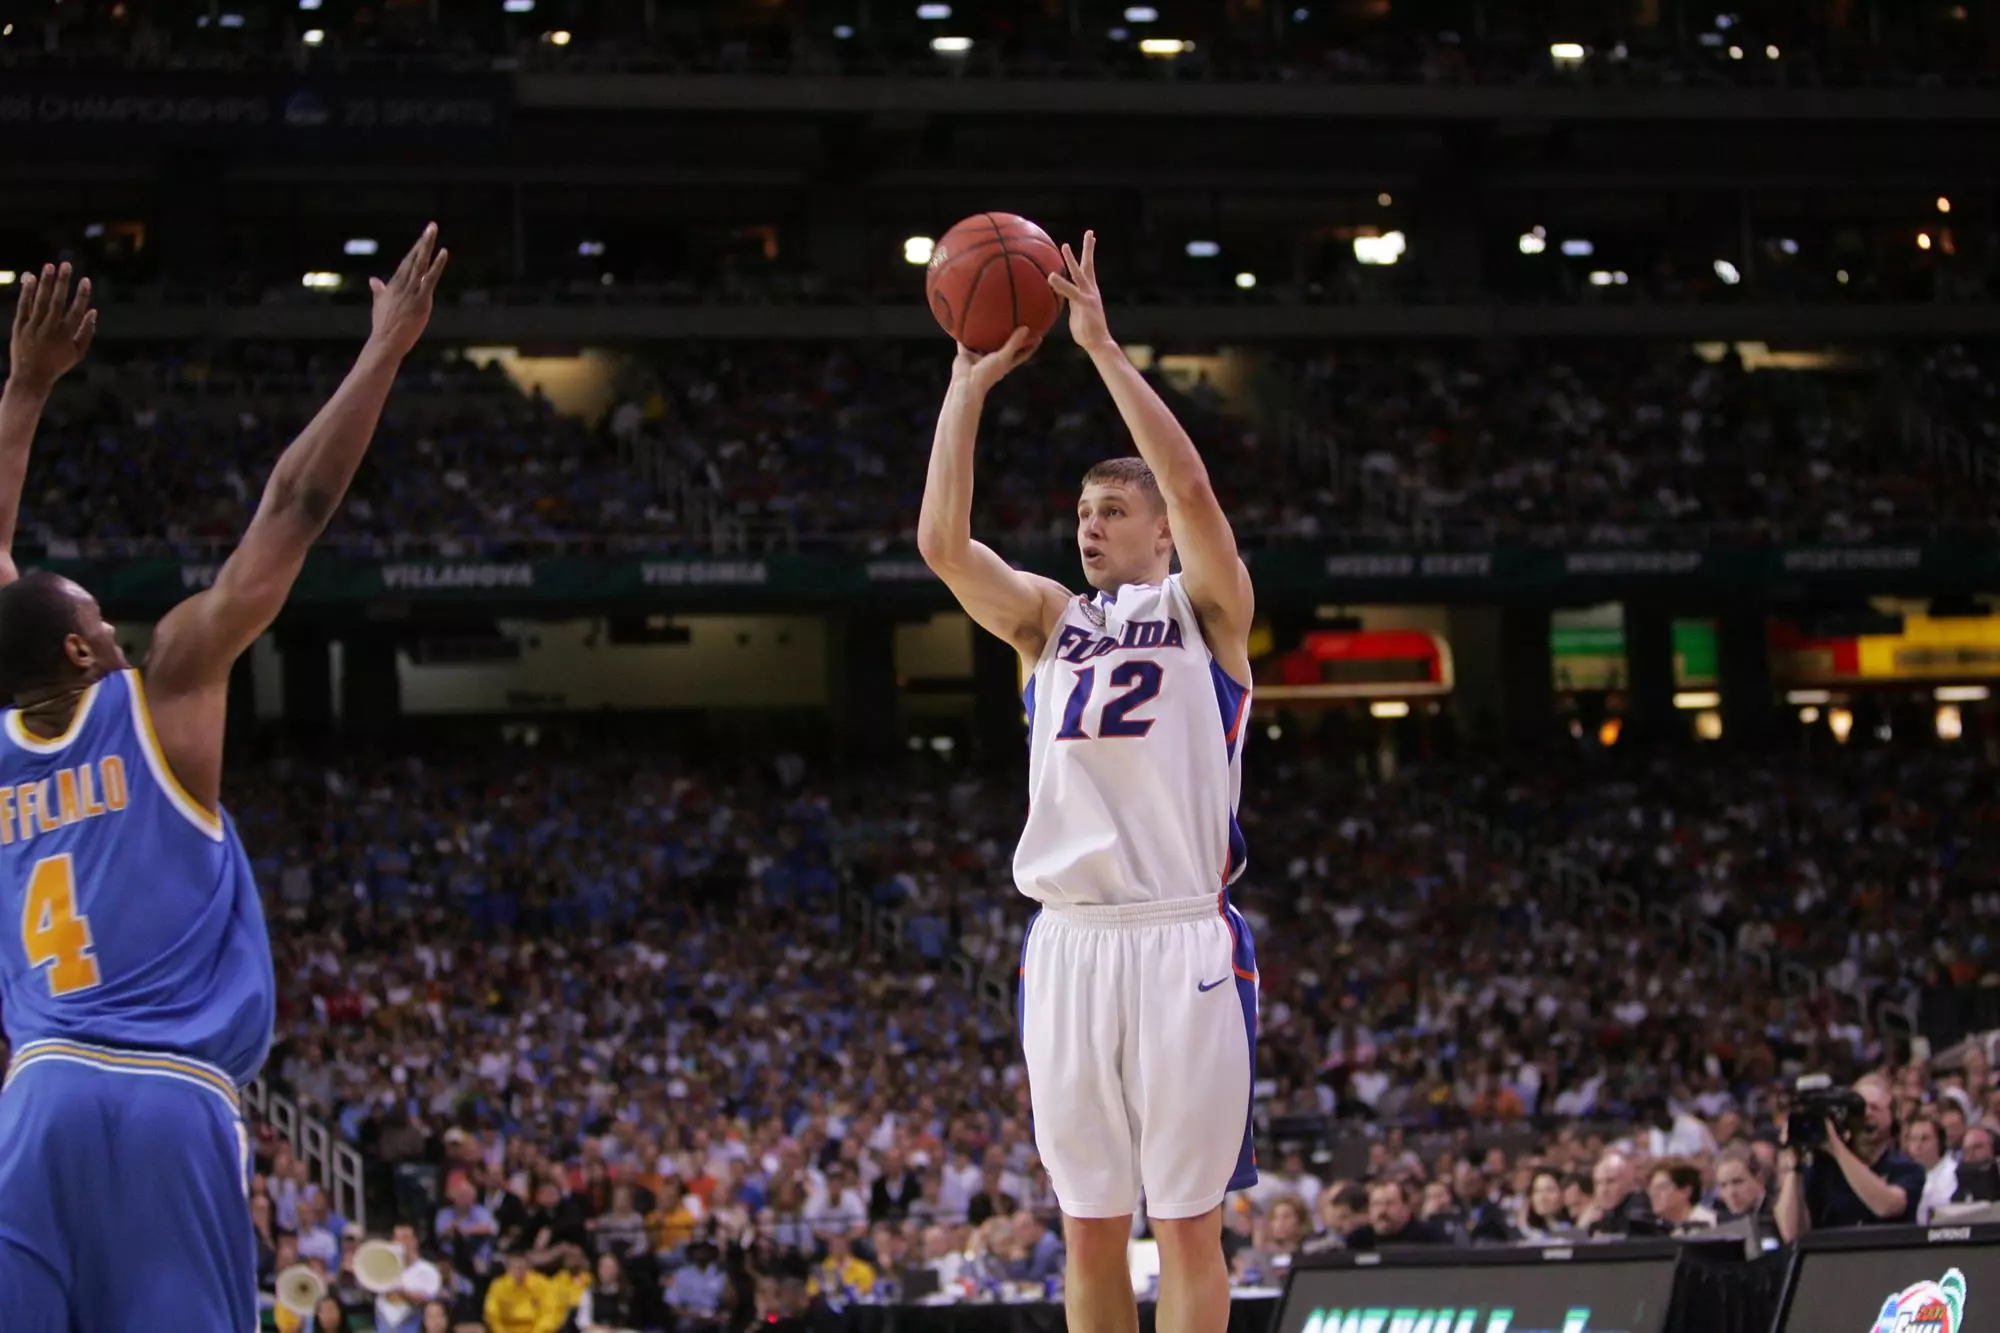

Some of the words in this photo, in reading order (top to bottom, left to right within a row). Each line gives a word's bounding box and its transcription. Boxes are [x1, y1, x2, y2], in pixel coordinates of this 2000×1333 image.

[38, 95, 269, 126] CHAMPIONSHIPS
[383, 97, 495, 126] SPORTS
[381, 563, 534, 589] VILLANOVA
[640, 561, 767, 585] VIRGINIA
[1420, 553, 1491, 577] STATE
[1565, 552, 1702, 574] WINTHROP
[1055, 660, 1164, 740] 12
[21, 852, 101, 998] 4
